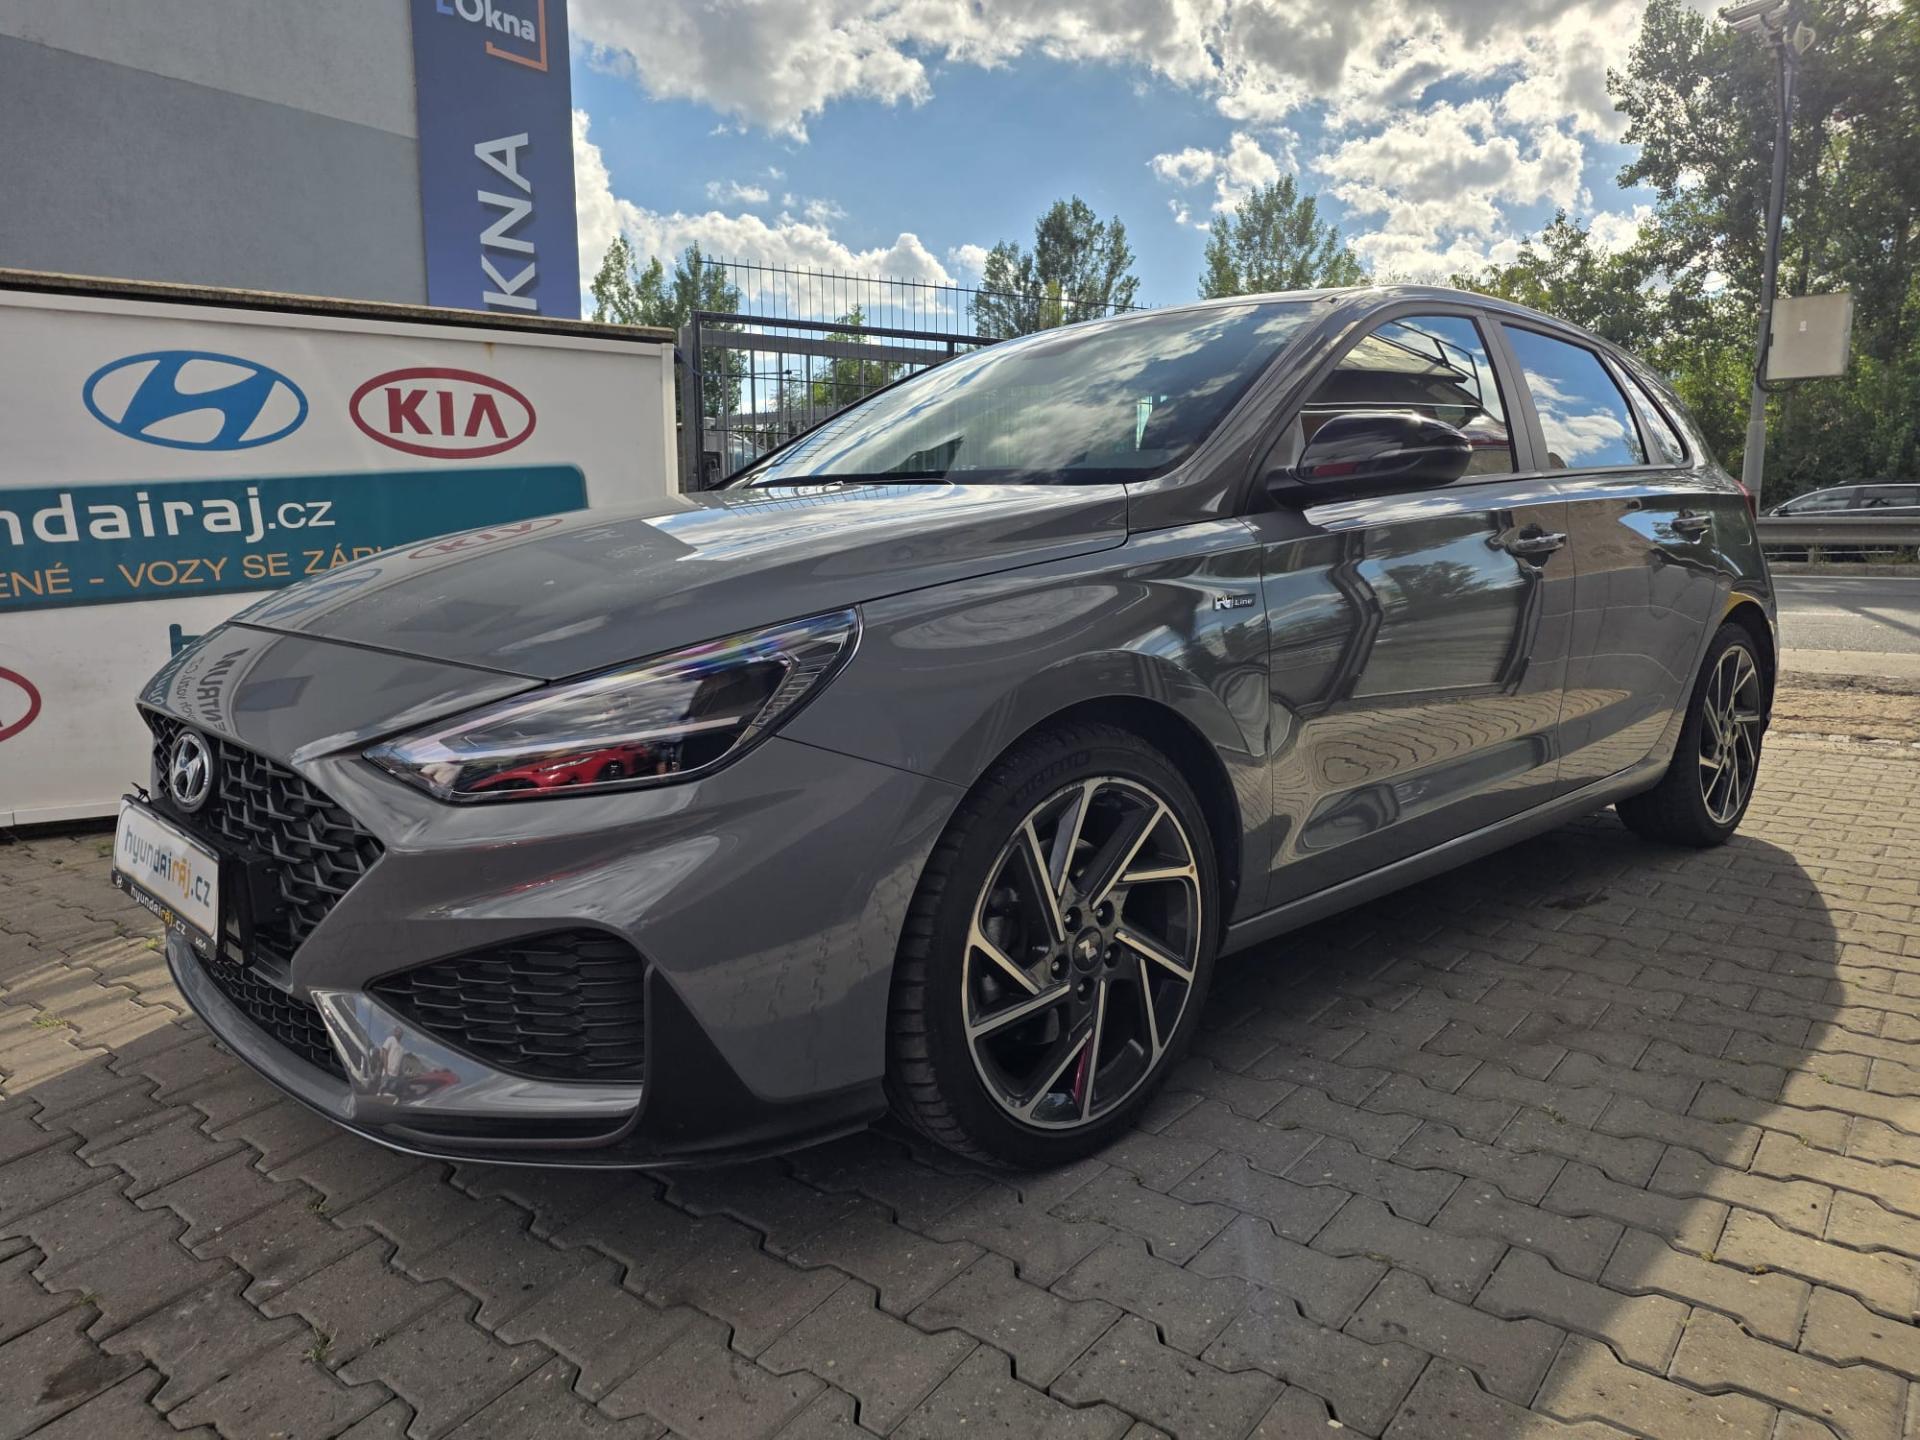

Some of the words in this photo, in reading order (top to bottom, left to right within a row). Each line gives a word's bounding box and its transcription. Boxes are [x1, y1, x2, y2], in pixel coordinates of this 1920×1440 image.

[474, 132, 537, 310] KNA
[385, 388, 508, 438] KIA
[117, 557, 228, 588] VOZY
[242, 552, 291, 579] SE
